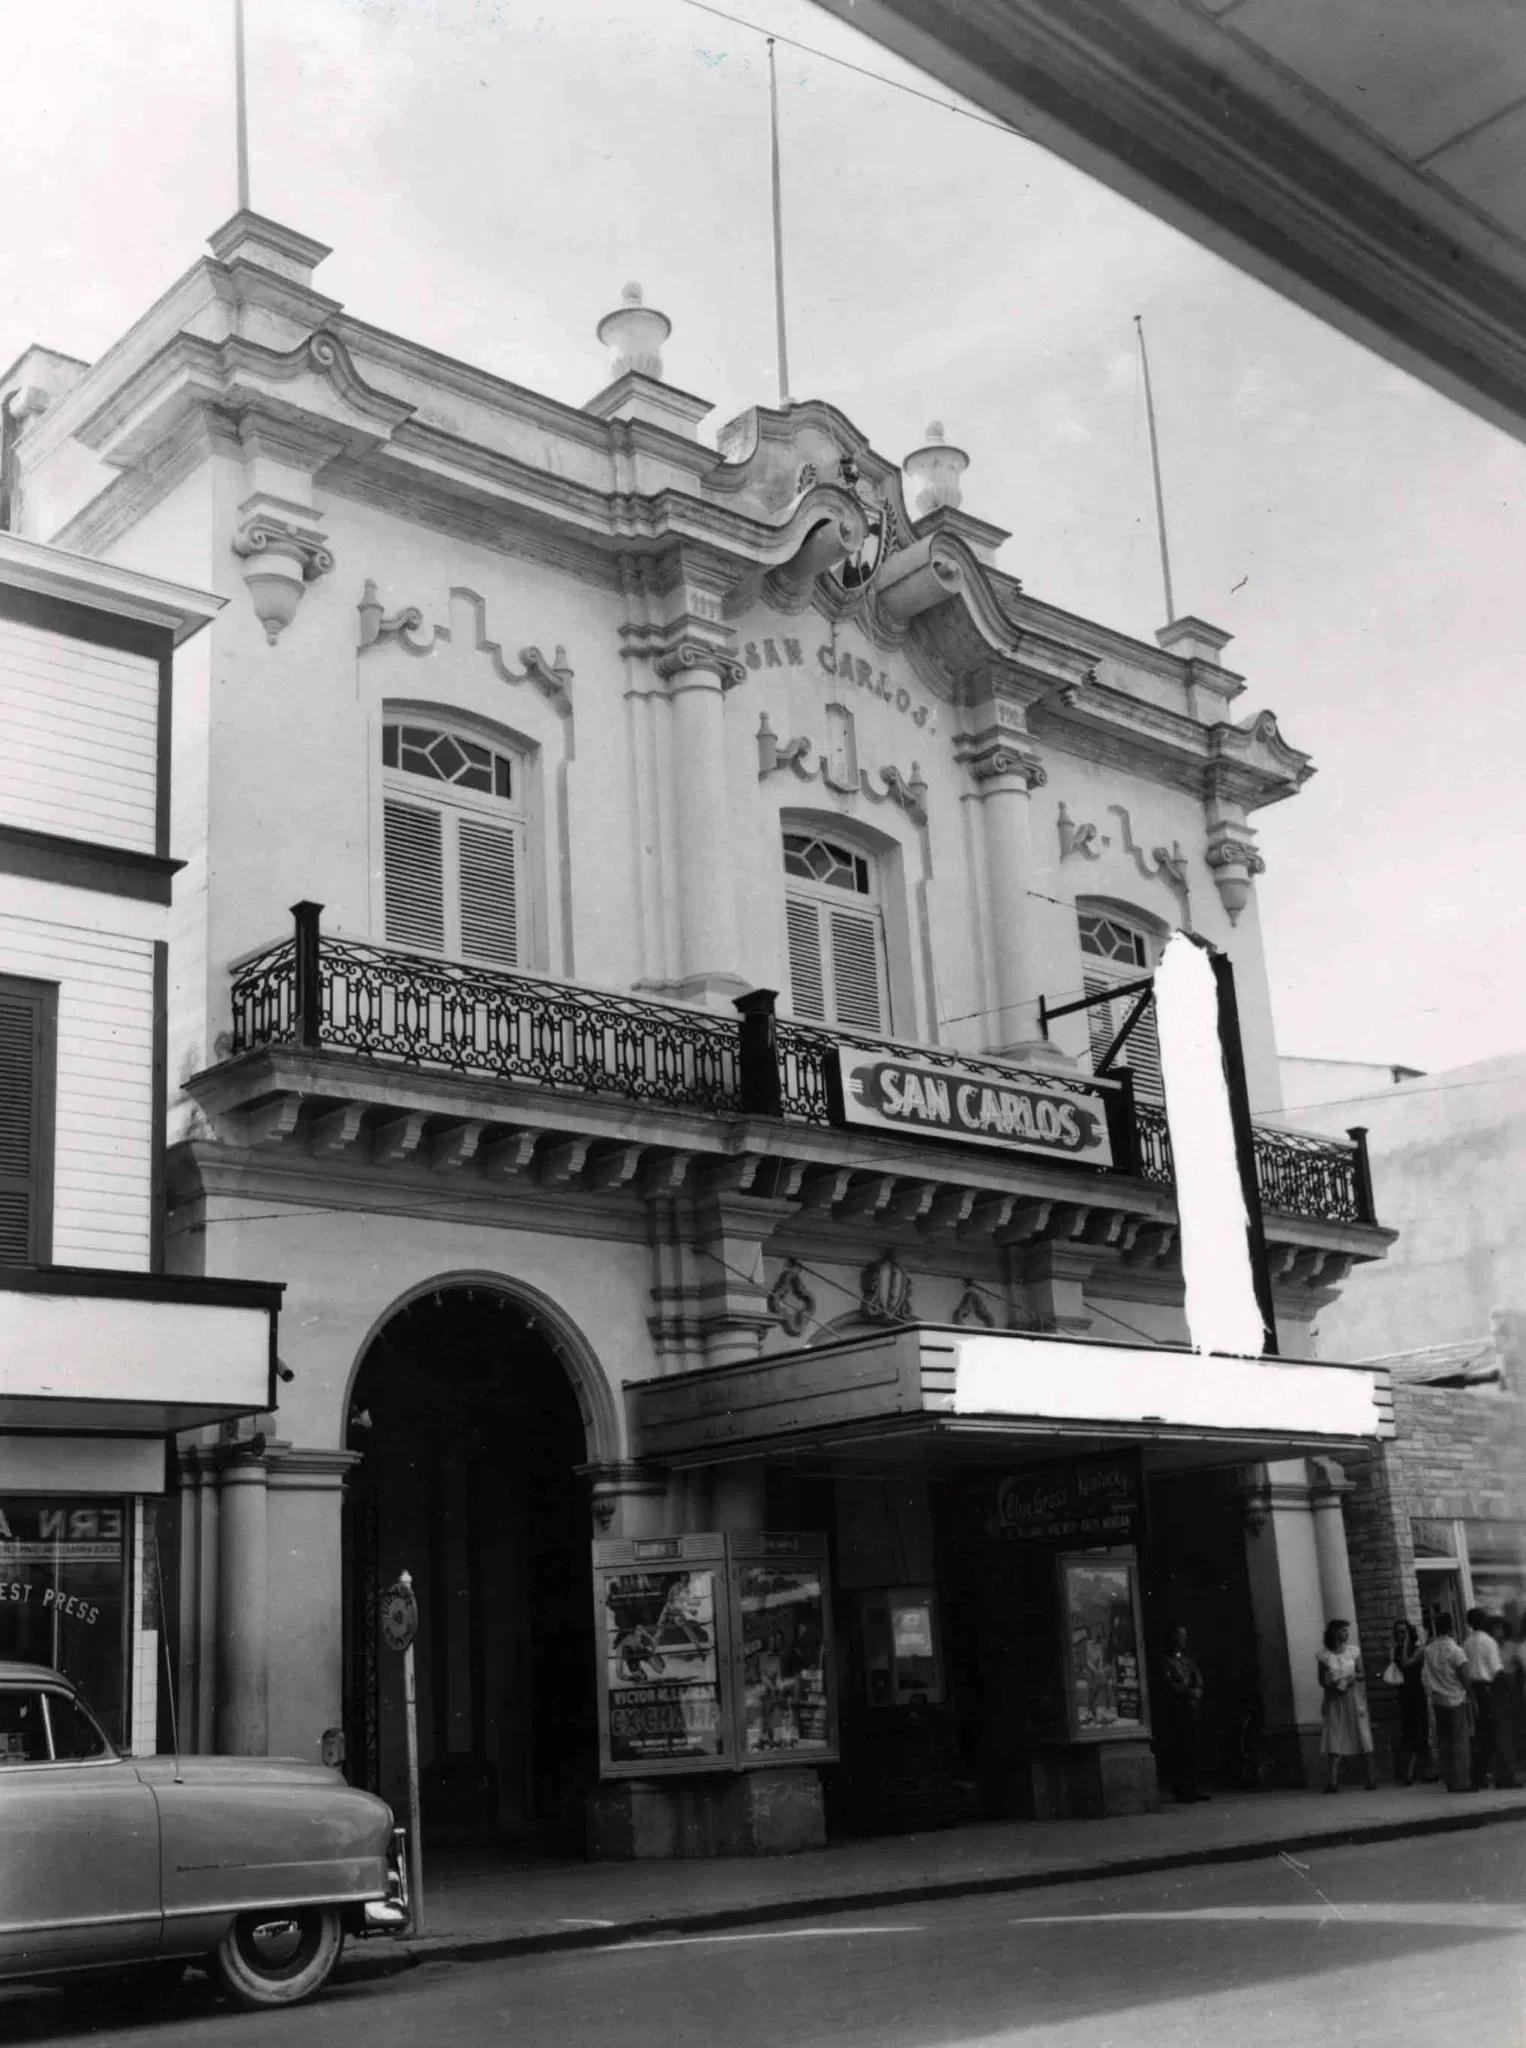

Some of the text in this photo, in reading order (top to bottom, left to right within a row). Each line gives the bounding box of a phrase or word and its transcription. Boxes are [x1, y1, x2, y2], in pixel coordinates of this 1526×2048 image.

[744, 638, 804, 671] SAN
[816, 643, 930, 729] CARLOS
[879, 1068, 1081, 1147] SAN CARLOS
[42, 1587, 101, 1625] PRESS
